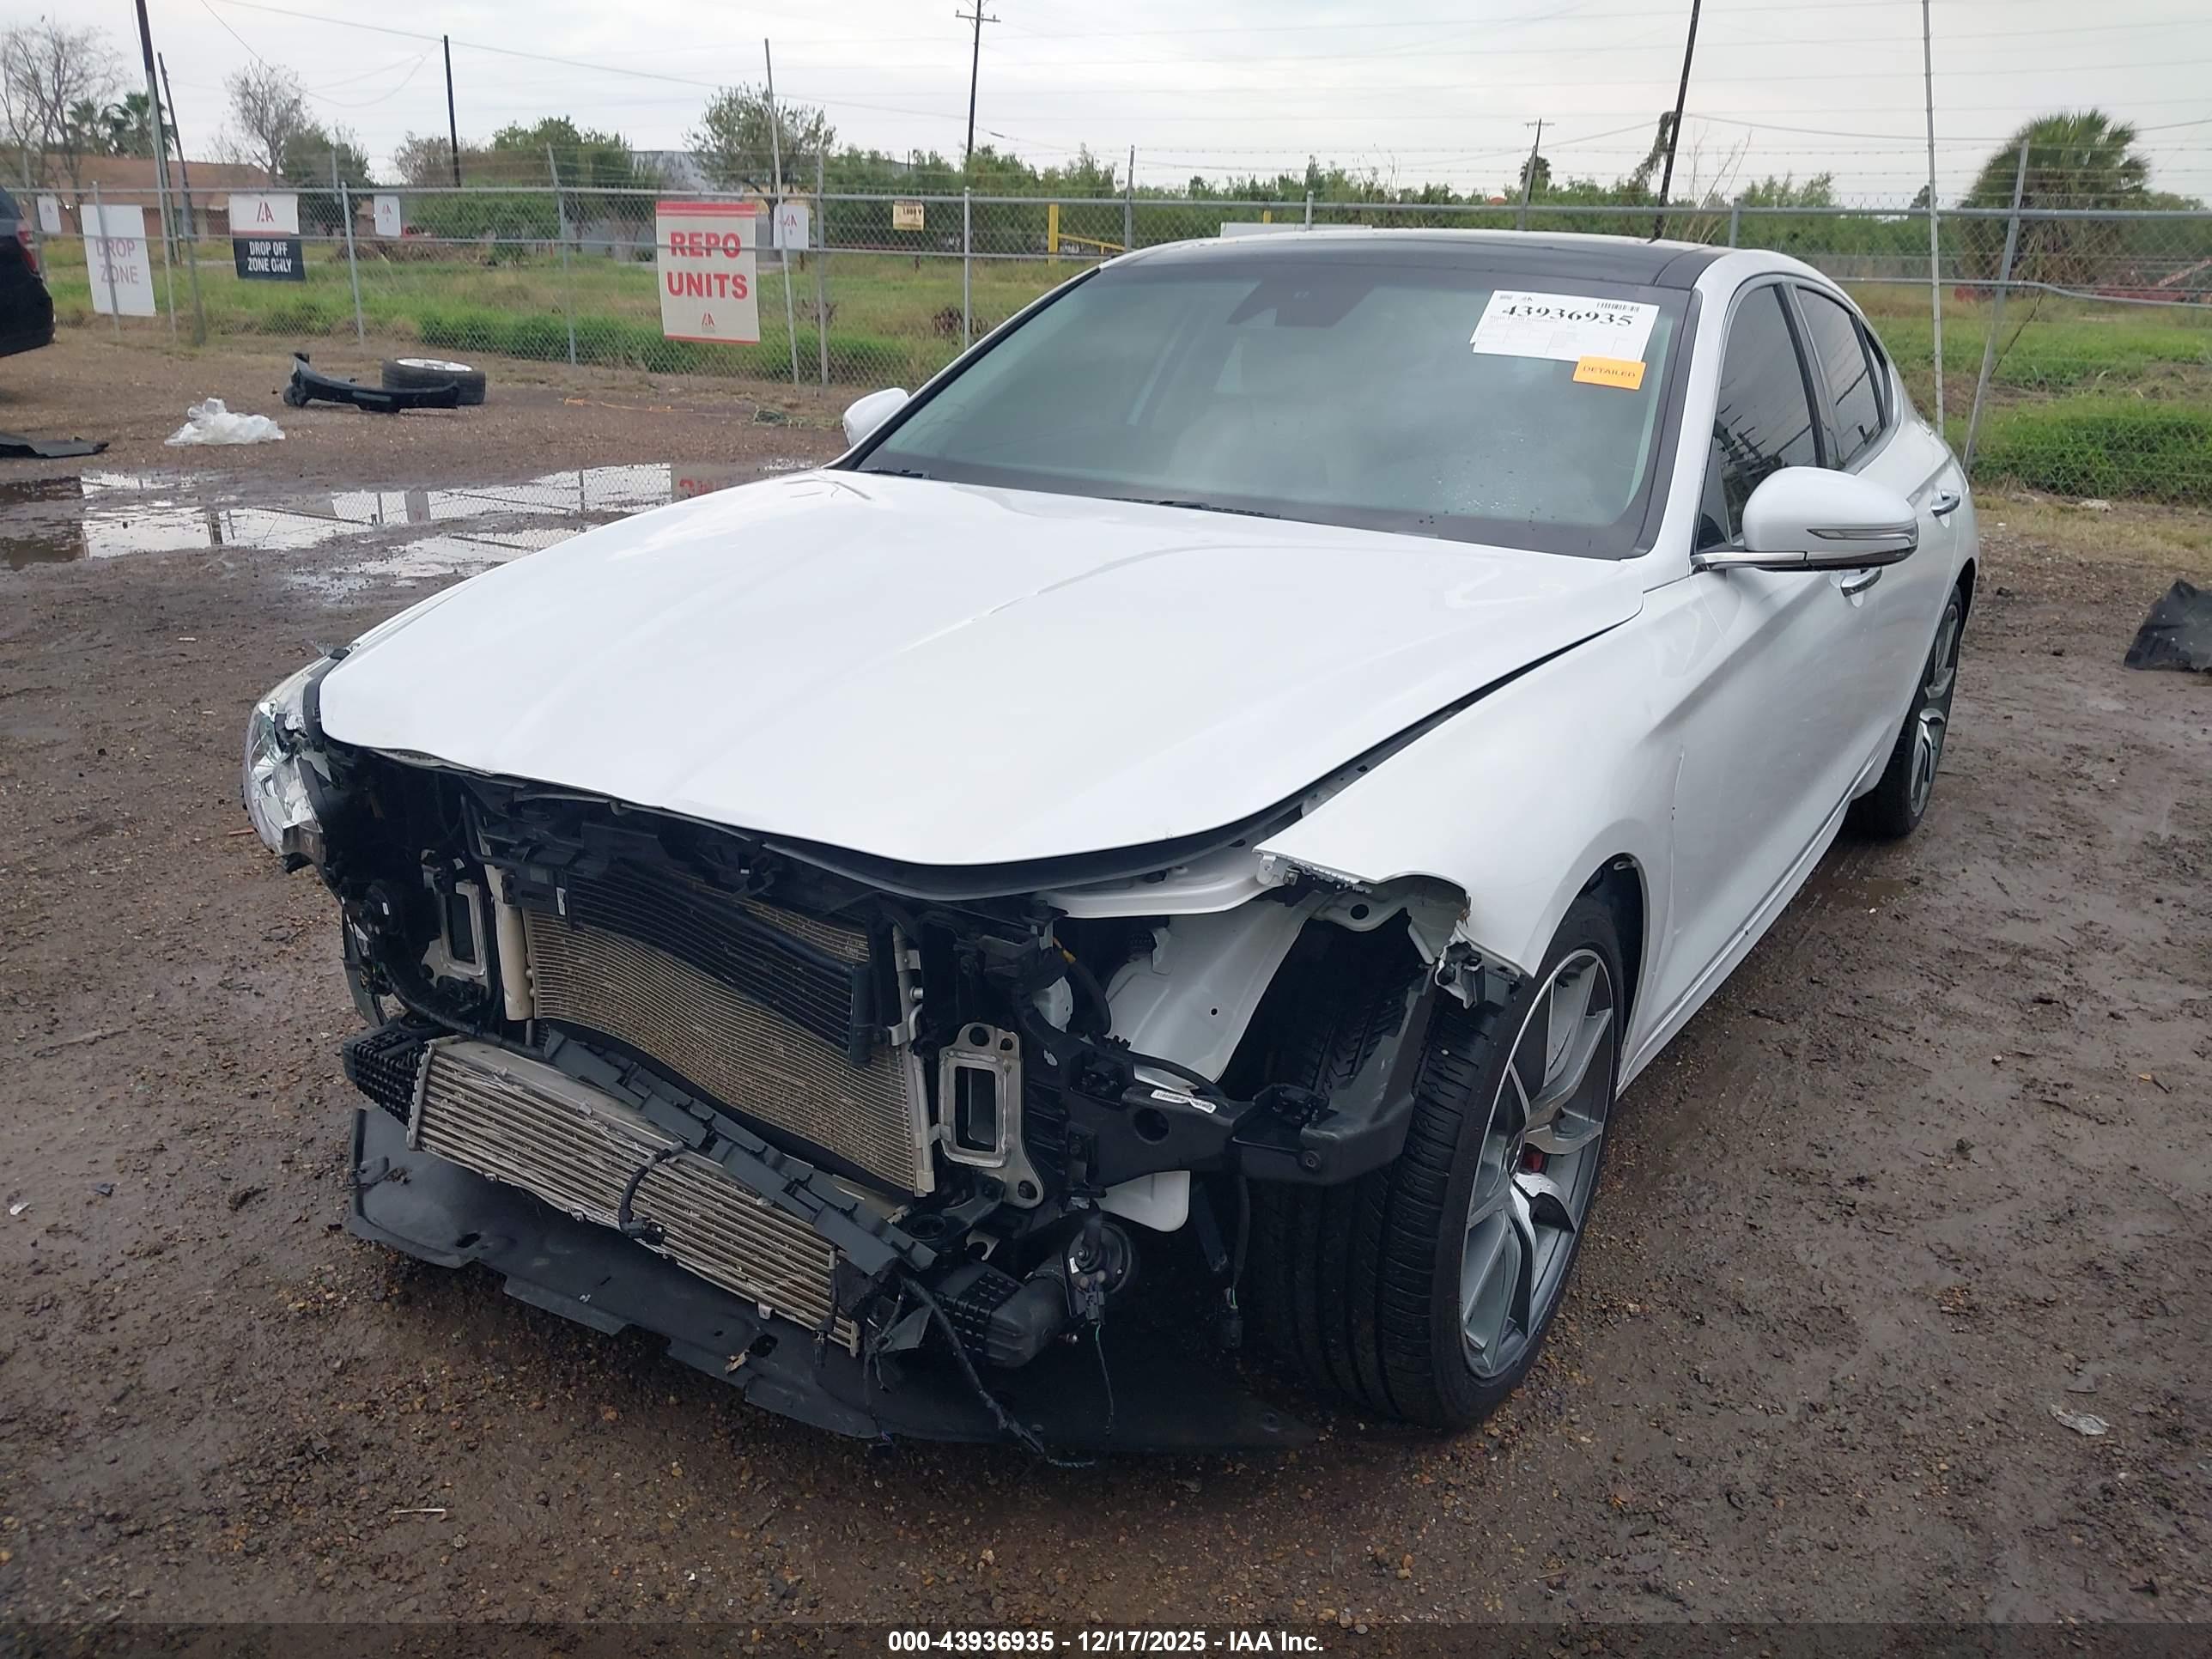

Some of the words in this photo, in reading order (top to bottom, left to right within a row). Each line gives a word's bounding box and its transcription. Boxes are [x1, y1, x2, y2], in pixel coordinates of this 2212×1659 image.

[94, 237, 136, 258] DROP
[248, 240, 271, 256] DROP
[272, 241, 289, 257] OFF
[670, 232, 741, 258] REPO
[99, 264, 140, 284] ZONE
[246, 257, 270, 273] ZONE
[270, 258, 292, 273] ONLY
[666, 271, 748, 300] UNITS
[1502, 304, 1634, 326] 43936935
[1583, 365, 1636, 379] DETAILED
